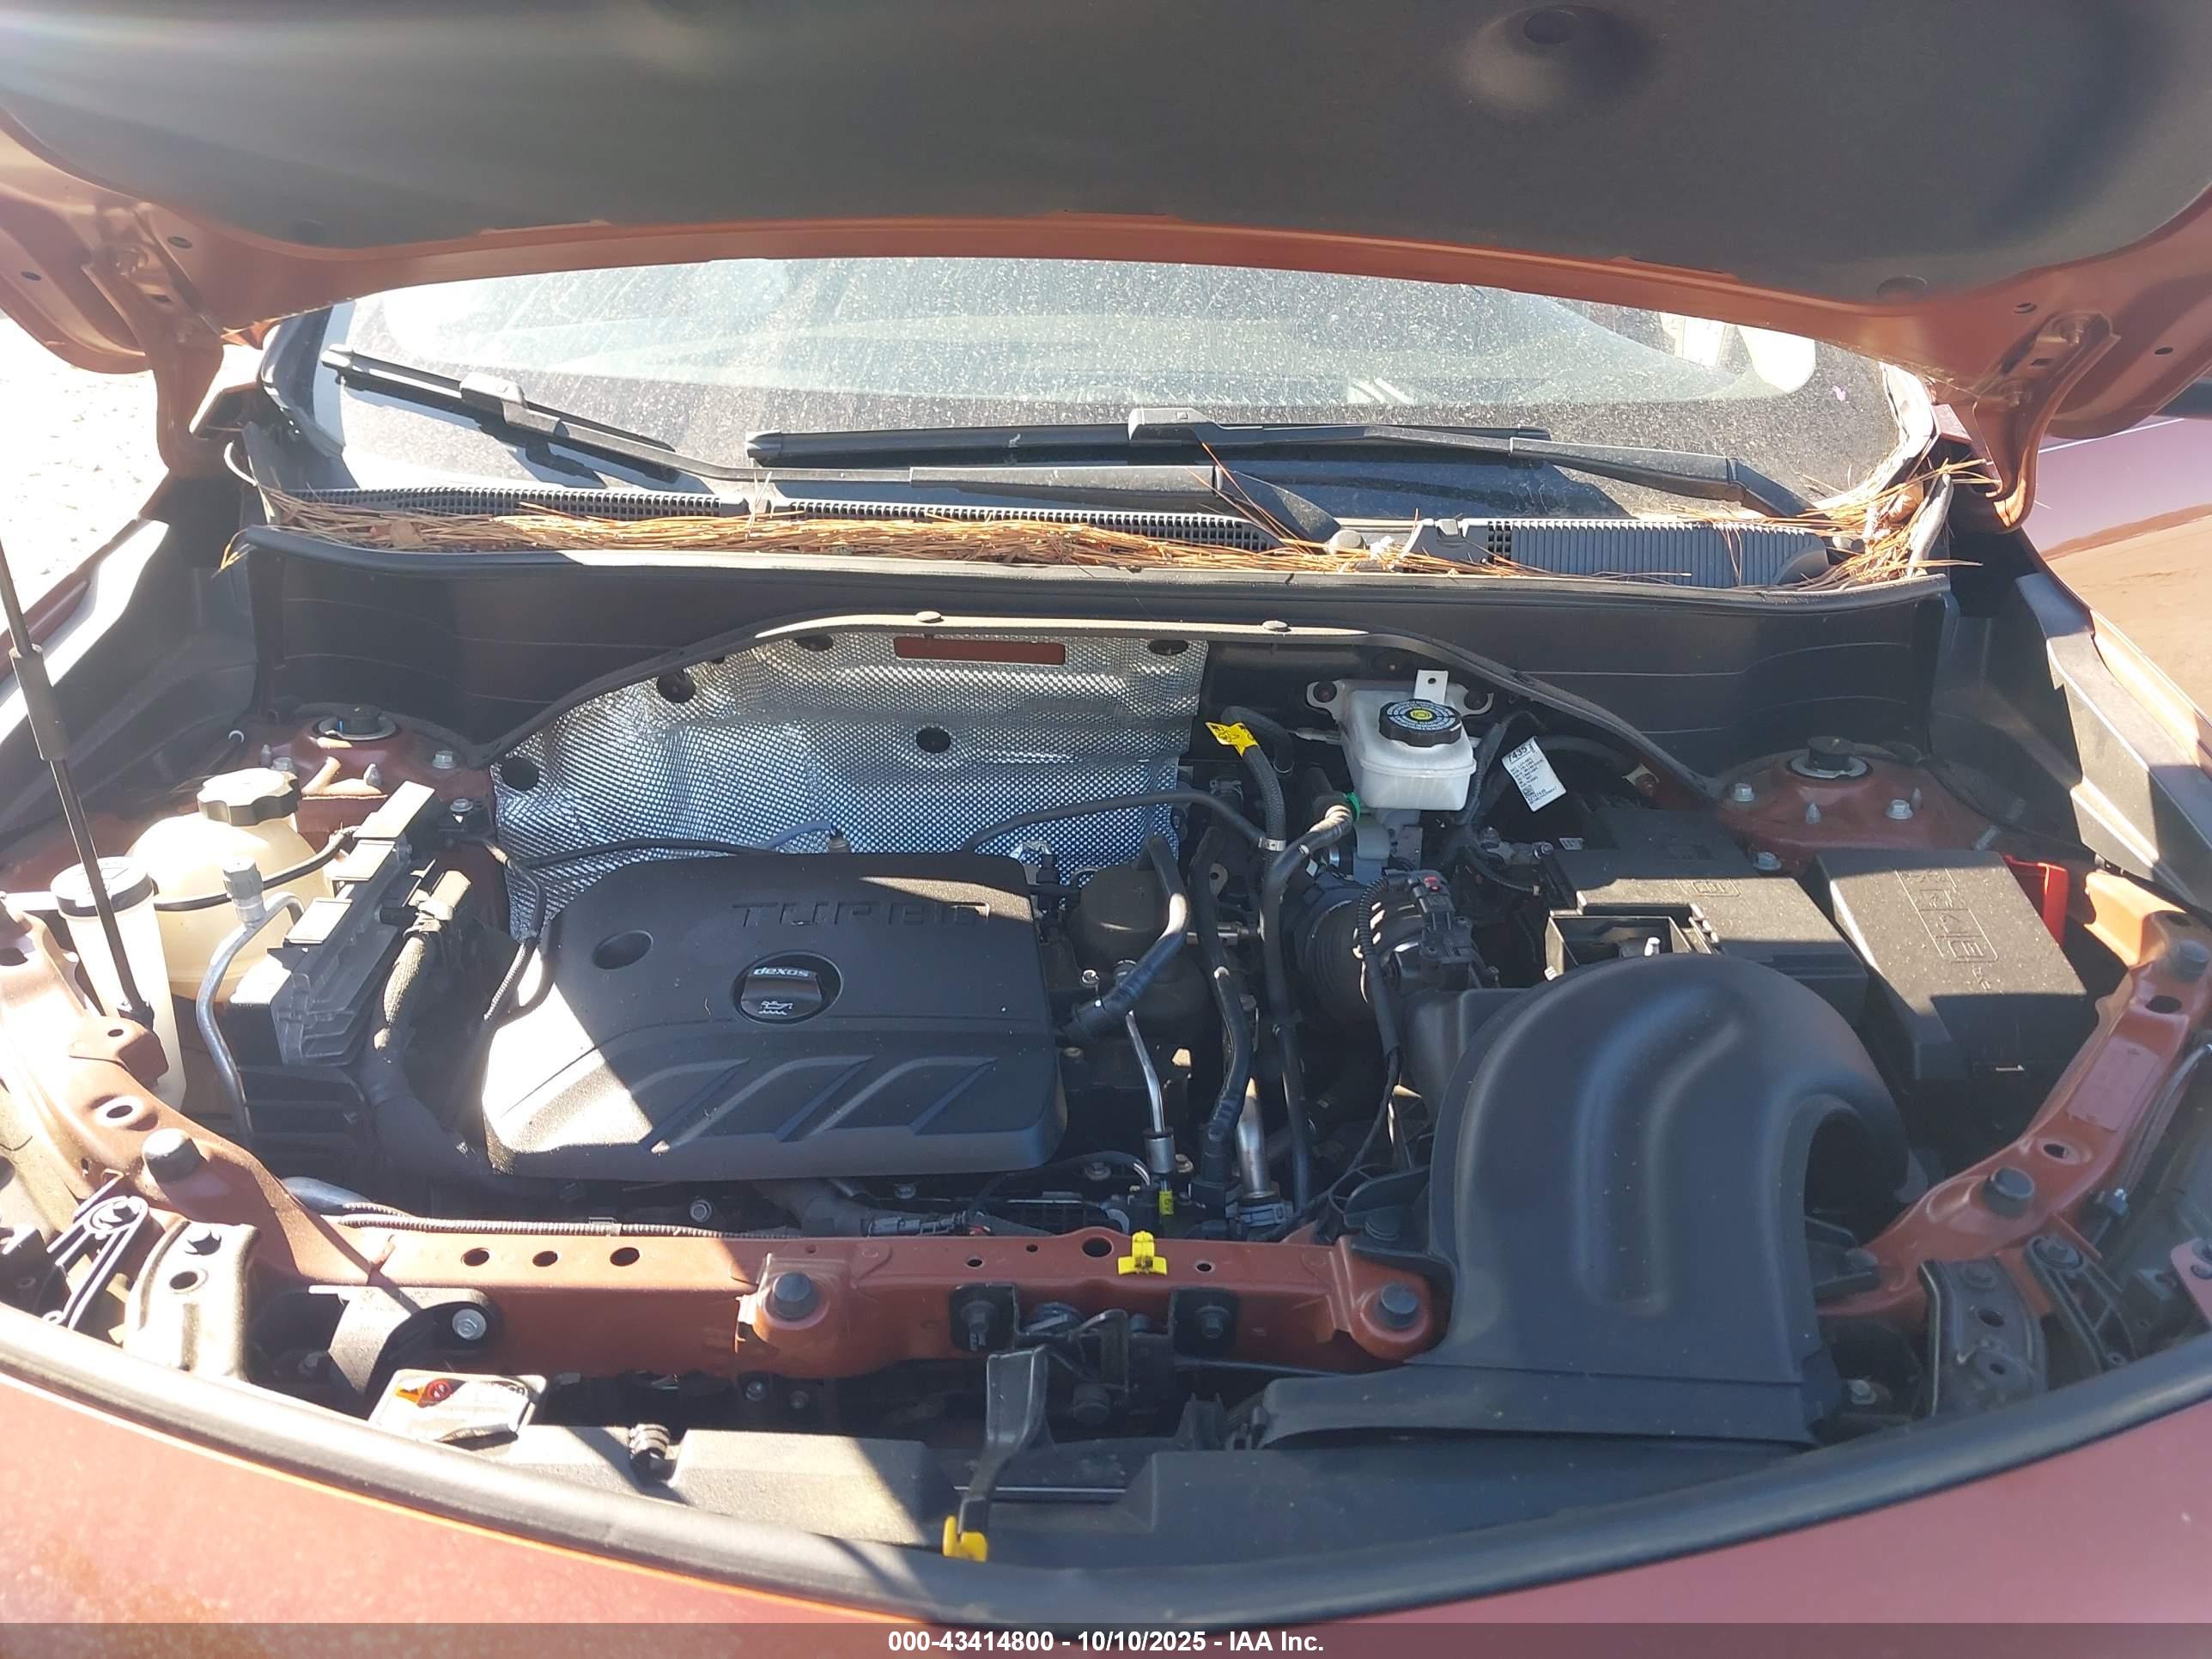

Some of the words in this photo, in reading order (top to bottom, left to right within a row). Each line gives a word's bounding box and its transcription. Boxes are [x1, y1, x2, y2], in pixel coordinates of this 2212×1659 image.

[1507, 744, 1528, 763] 7435
[732, 900, 990, 928] TURBO
[753, 967, 810, 977] dexos
